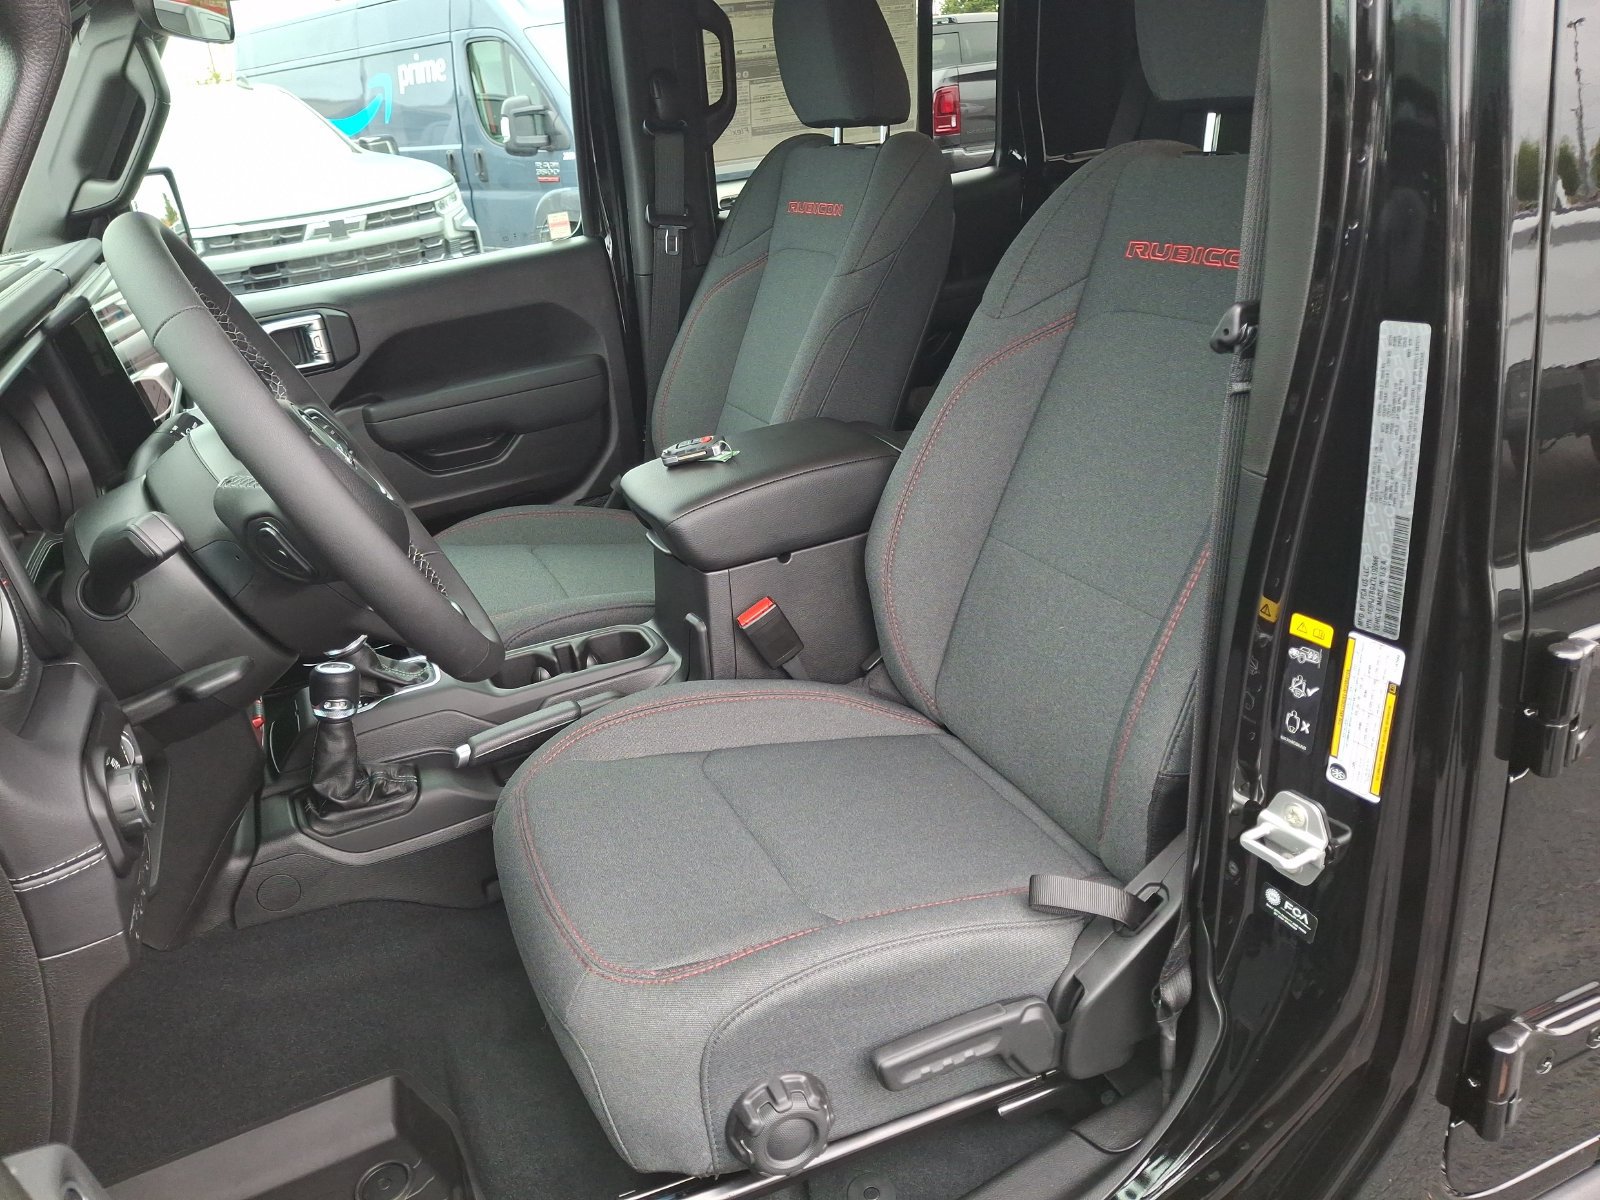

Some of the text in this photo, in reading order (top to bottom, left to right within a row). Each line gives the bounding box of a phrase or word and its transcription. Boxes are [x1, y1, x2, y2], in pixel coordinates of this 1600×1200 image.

[397, 53, 447, 95] prime
[787, 201, 845, 216] RUBICON
[1125, 240, 1241, 269] RUBICO
[1283, 900, 1309, 925] FCA
